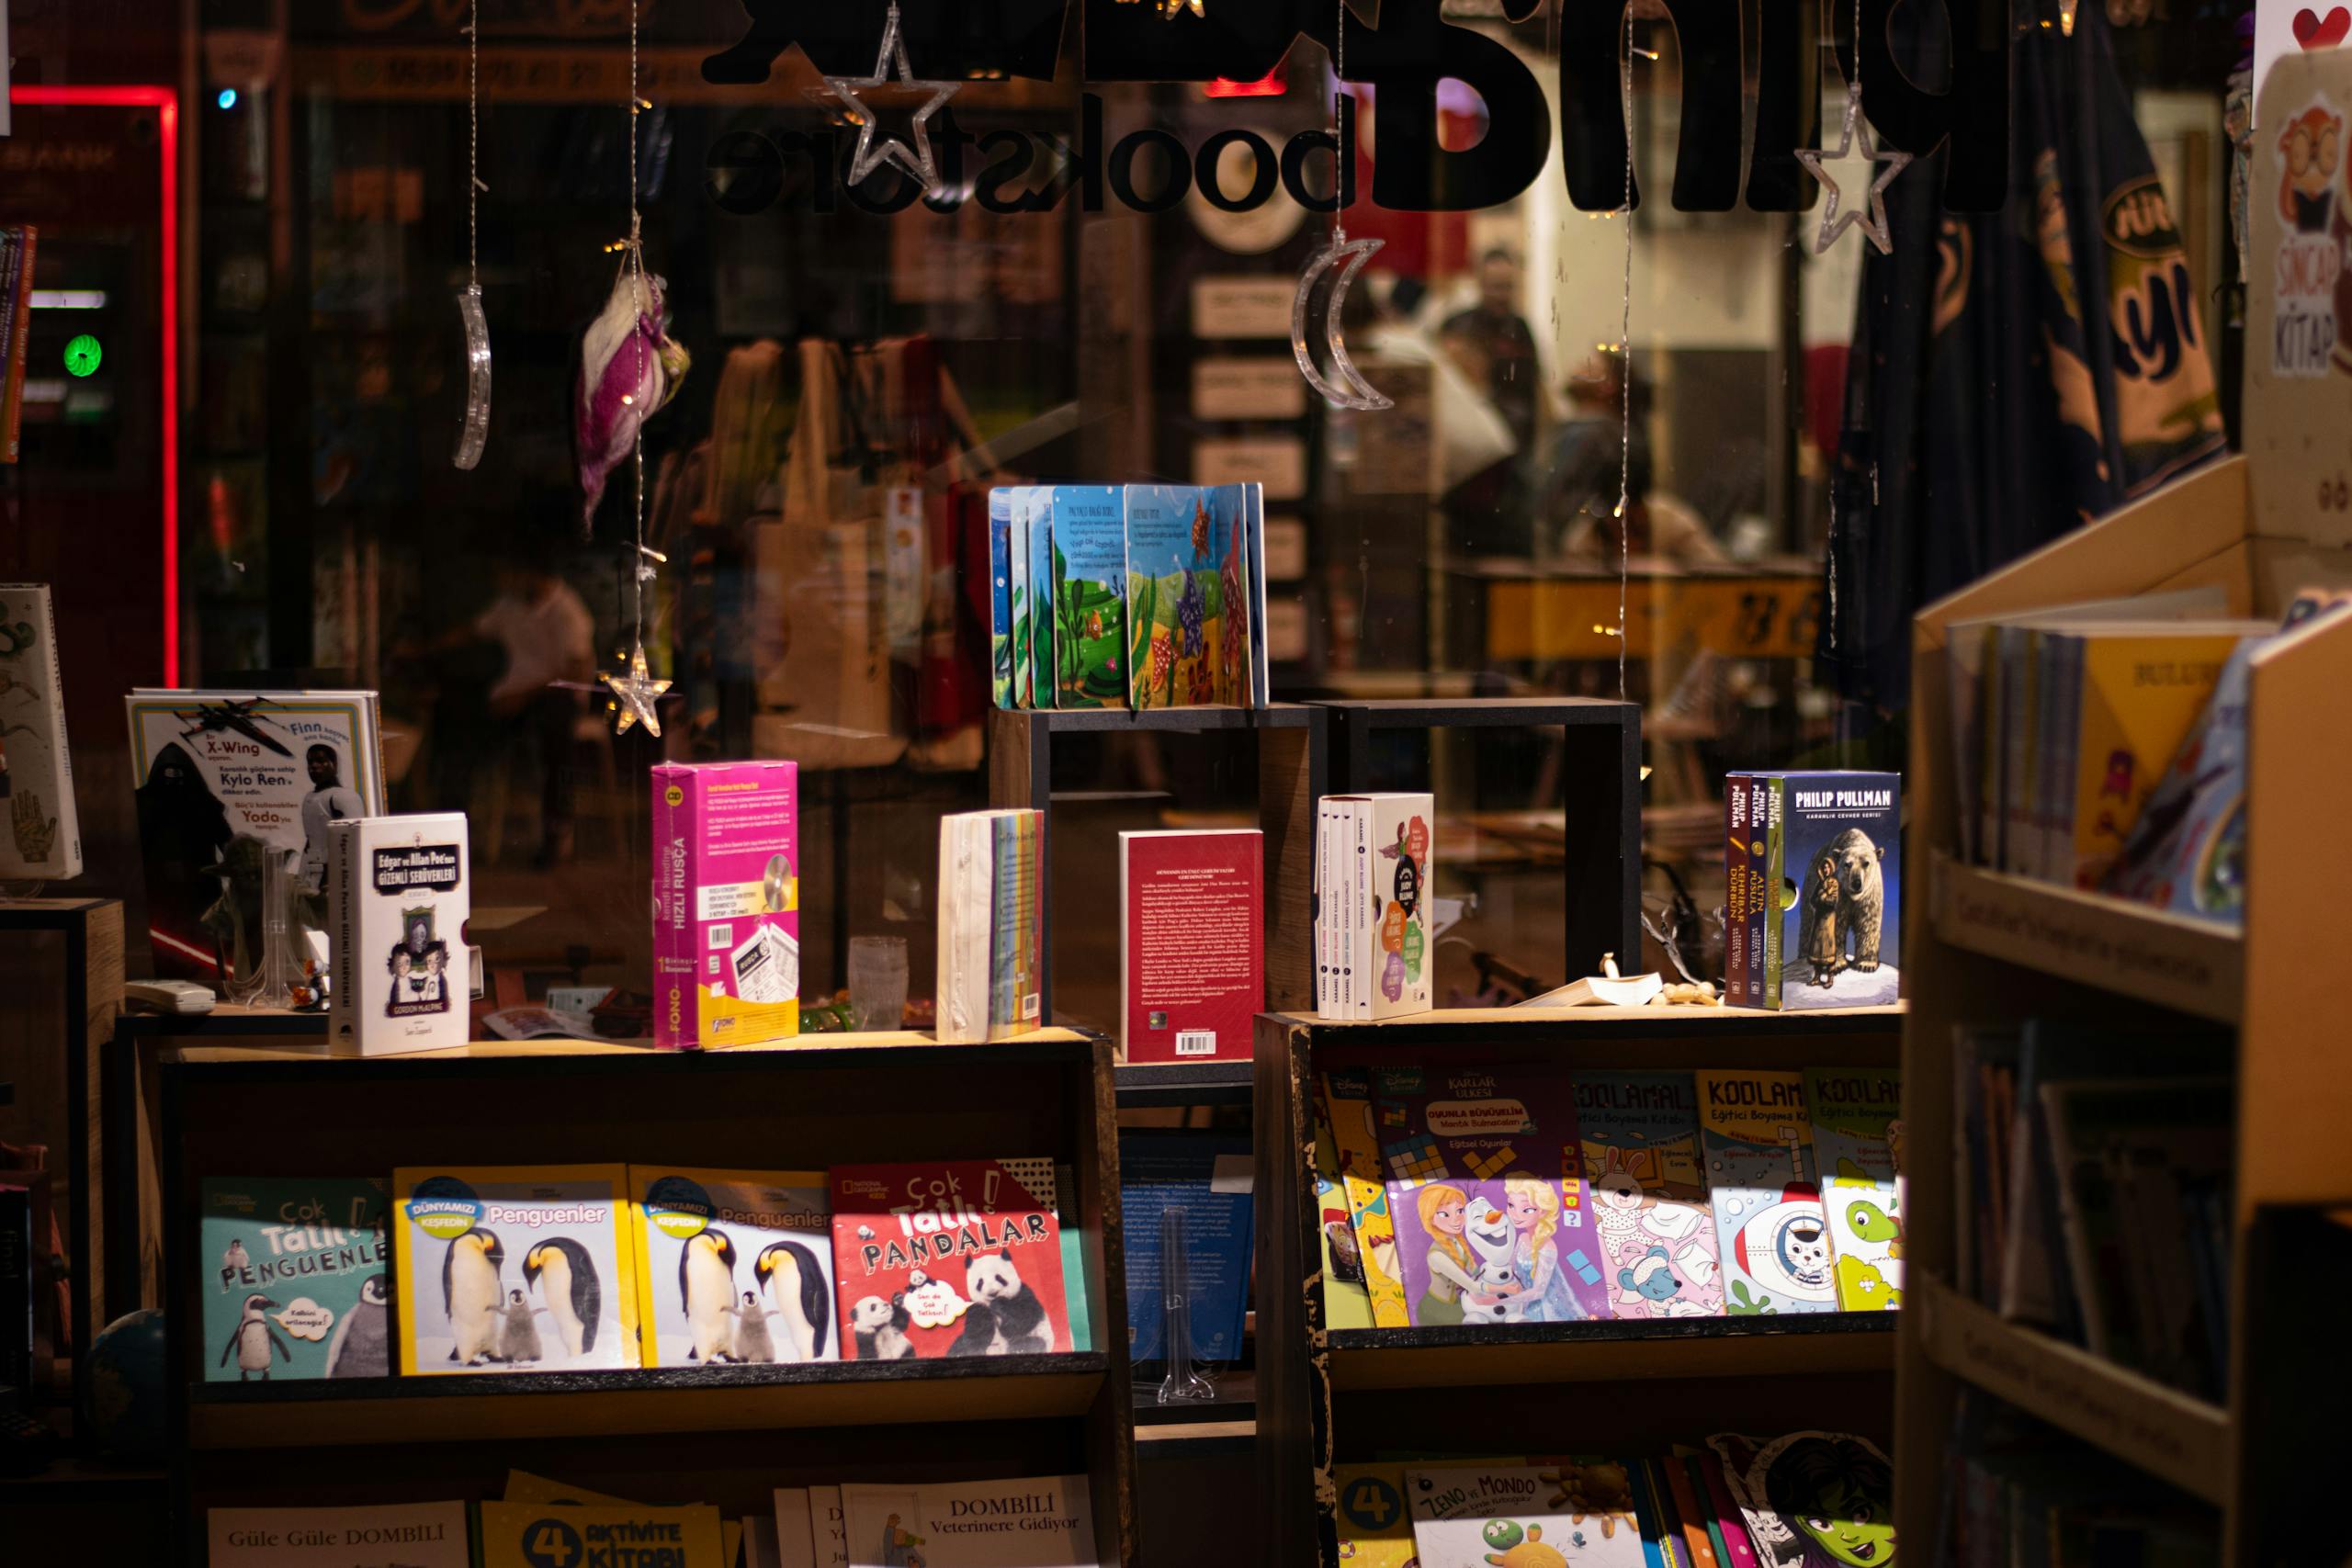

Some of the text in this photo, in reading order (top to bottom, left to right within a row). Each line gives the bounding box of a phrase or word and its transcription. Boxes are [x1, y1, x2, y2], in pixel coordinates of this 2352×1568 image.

[290, 722, 322, 737] Finn
[208, 741, 260, 757] X-Wing
[220, 773, 252, 789] Kylo
[666, 790, 682, 802] CD
[1751, 784, 1759, 828] PULLMAN
[1795, 790, 1891, 808] PHILIP PULLMAN
[1731, 785, 1747, 829] PHILIP PULLMAN
[1768, 786, 1776, 829] PULLMAN
[379, 853, 402, 872] Edgar
[402, 859, 411, 867] ve
[410, 852, 430, 866] Allan
[379, 866, 457, 886] GİZEMLİ SERÜVENLERİ
[673, 837, 688, 930] HIZLI RUSÇA
[1749, 870, 1758, 915] PUSULA
[394, 1005, 418, 1015] GORDON
[669, 987, 682, 1032] FONO
[1447, 1076, 1498, 1090] KARLAR
[1429, 1110, 1467, 1119] OYUNLA
[1605, 1113, 1685, 1126] Boyama Kitabı
[1711, 1109, 1747, 1122] Eğitici
[1750, 1110, 1793, 1123] Boyama
[1449, 1138, 1513, 1150] Eğitsel Oyunlar
[907, 1169, 962, 1209] Çok
[278, 1197, 327, 1231] Çok
[412, 1200, 476, 1215] DÜNYAMIZI
[489, 1203, 606, 1228] Penguenler
[648, 1201, 708, 1216] DÜNYAMIZI
[421, 1216, 469, 1228] KEŞFEDİN
[656, 1216, 703, 1228] KEŞFEDİN
[719, 1206, 831, 1231] Penguenler
[860, 1213, 1049, 1276] PANDALAR
[949, 1492, 1056, 1517] DOMBİLİ
[1351, 1484, 1391, 1523] 4
[1419, 1487, 1466, 1518] ZENO
[1477, 1475, 1536, 1496] MONDO
[228, 1523, 445, 1547] Güle Güle DOMBİLİ
[586, 1519, 684, 1542] AKTİVİTE
[931, 1516, 1080, 1535] Veterinere Gidiyor
[531, 1527, 573, 1567] 4
